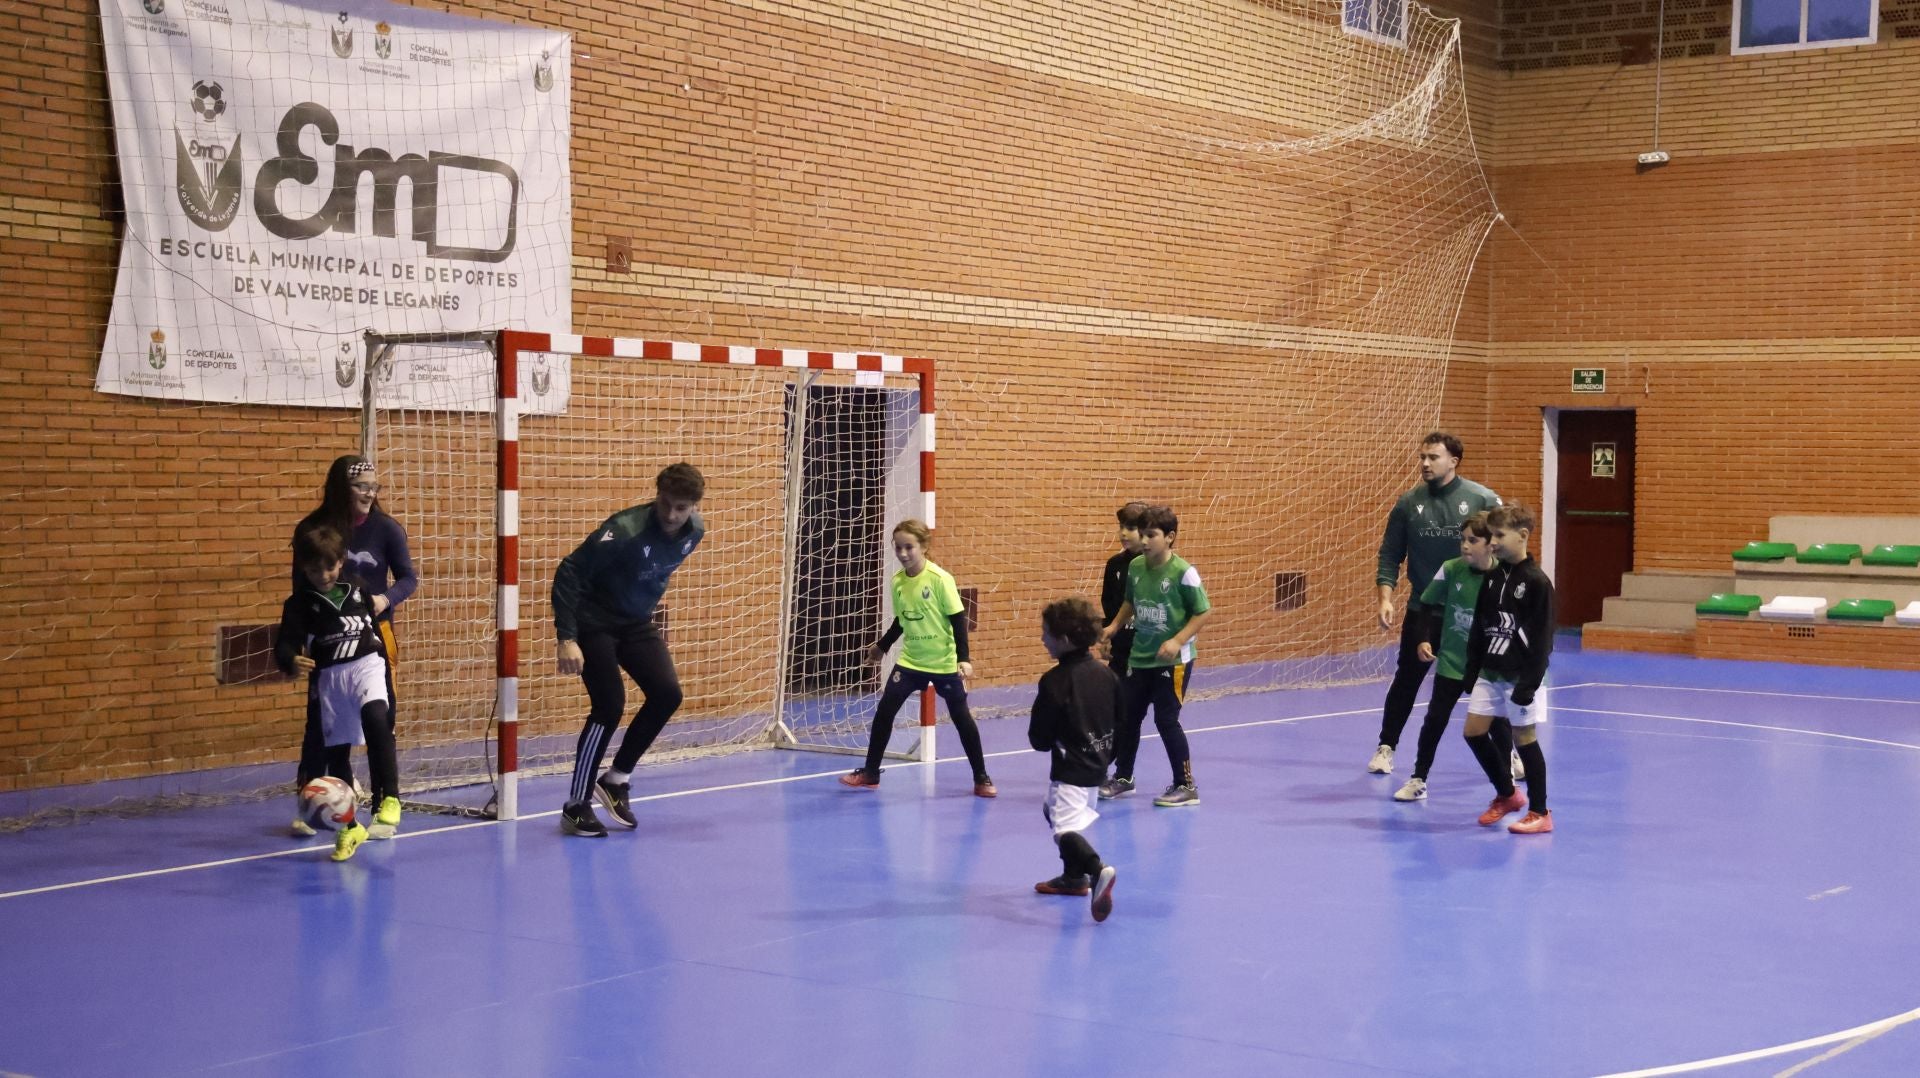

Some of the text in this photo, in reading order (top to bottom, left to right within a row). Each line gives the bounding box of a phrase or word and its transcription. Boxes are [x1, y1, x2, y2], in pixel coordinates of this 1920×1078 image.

[160, 238, 518, 288] ESCUELA MUNICIPAL DE DEPORTES
[234, 276, 460, 311] DE VALVERDE DE LEGANÉS
[196, 360, 237, 370] DEPORTES
